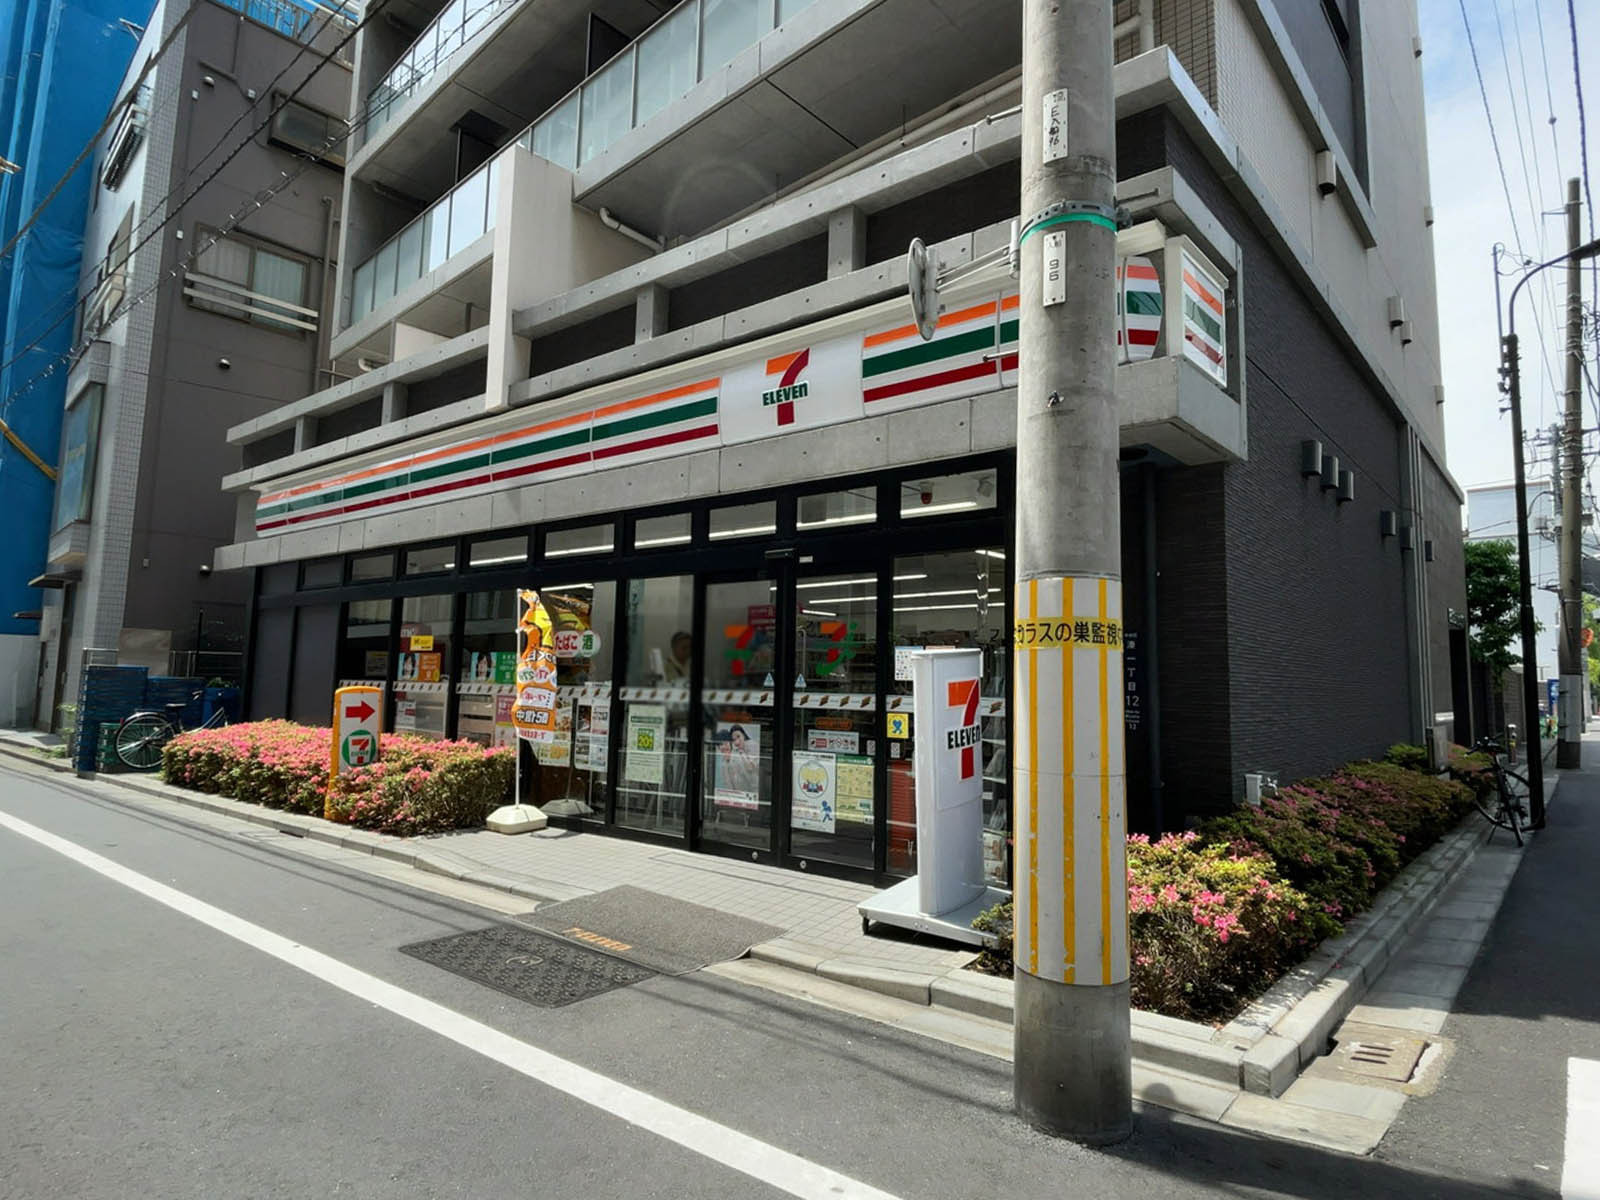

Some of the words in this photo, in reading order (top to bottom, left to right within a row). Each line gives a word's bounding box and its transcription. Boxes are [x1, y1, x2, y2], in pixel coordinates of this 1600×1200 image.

[766, 348, 810, 426] 7
[555, 634, 578, 650] たばこ
[1127, 695, 1140, 707] 12
[947, 679, 980, 779] 7
